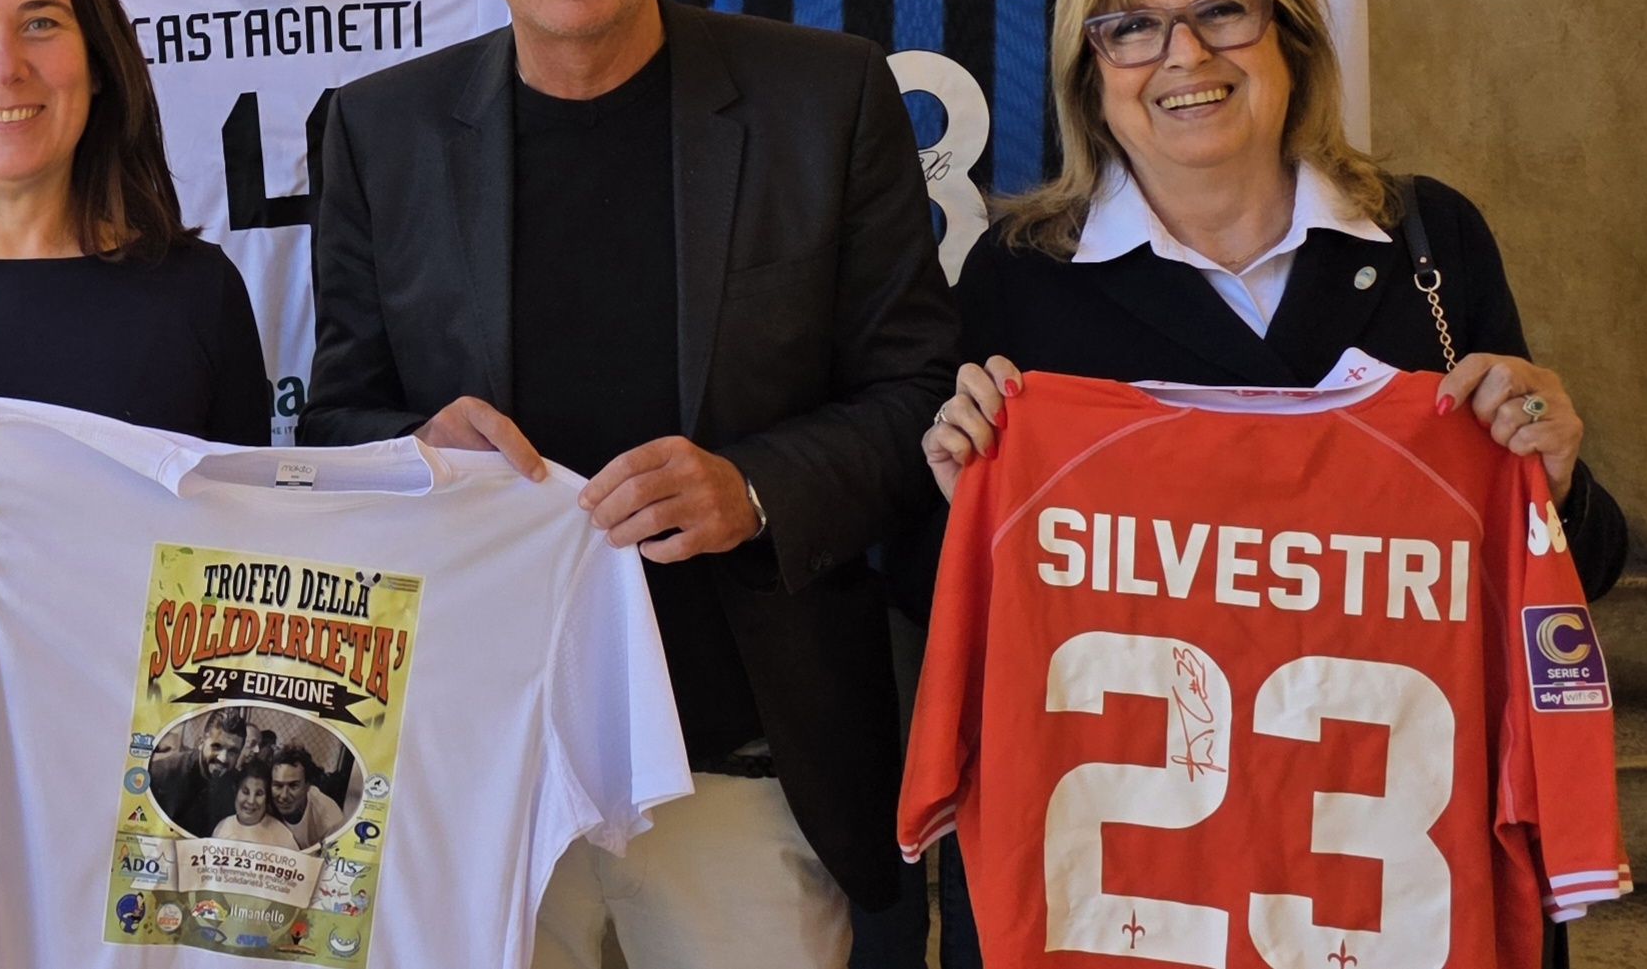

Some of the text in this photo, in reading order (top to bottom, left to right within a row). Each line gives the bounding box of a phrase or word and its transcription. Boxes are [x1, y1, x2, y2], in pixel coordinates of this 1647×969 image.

[1038, 506, 1471, 622] SILVESTRI
[203, 562, 370, 619] TROFEO DELLA
[1547, 666, 1591, 680] SERIE C
[243, 672, 336, 707] EDIZIONE
[1539, 689, 1563, 706] sky
[1043, 630, 1456, 969] 23
[120, 856, 160, 874] ADO
[191, 855, 305, 882] 21 22 23 maggio
[202, 845, 297, 868] PONTELAGOSCURO
